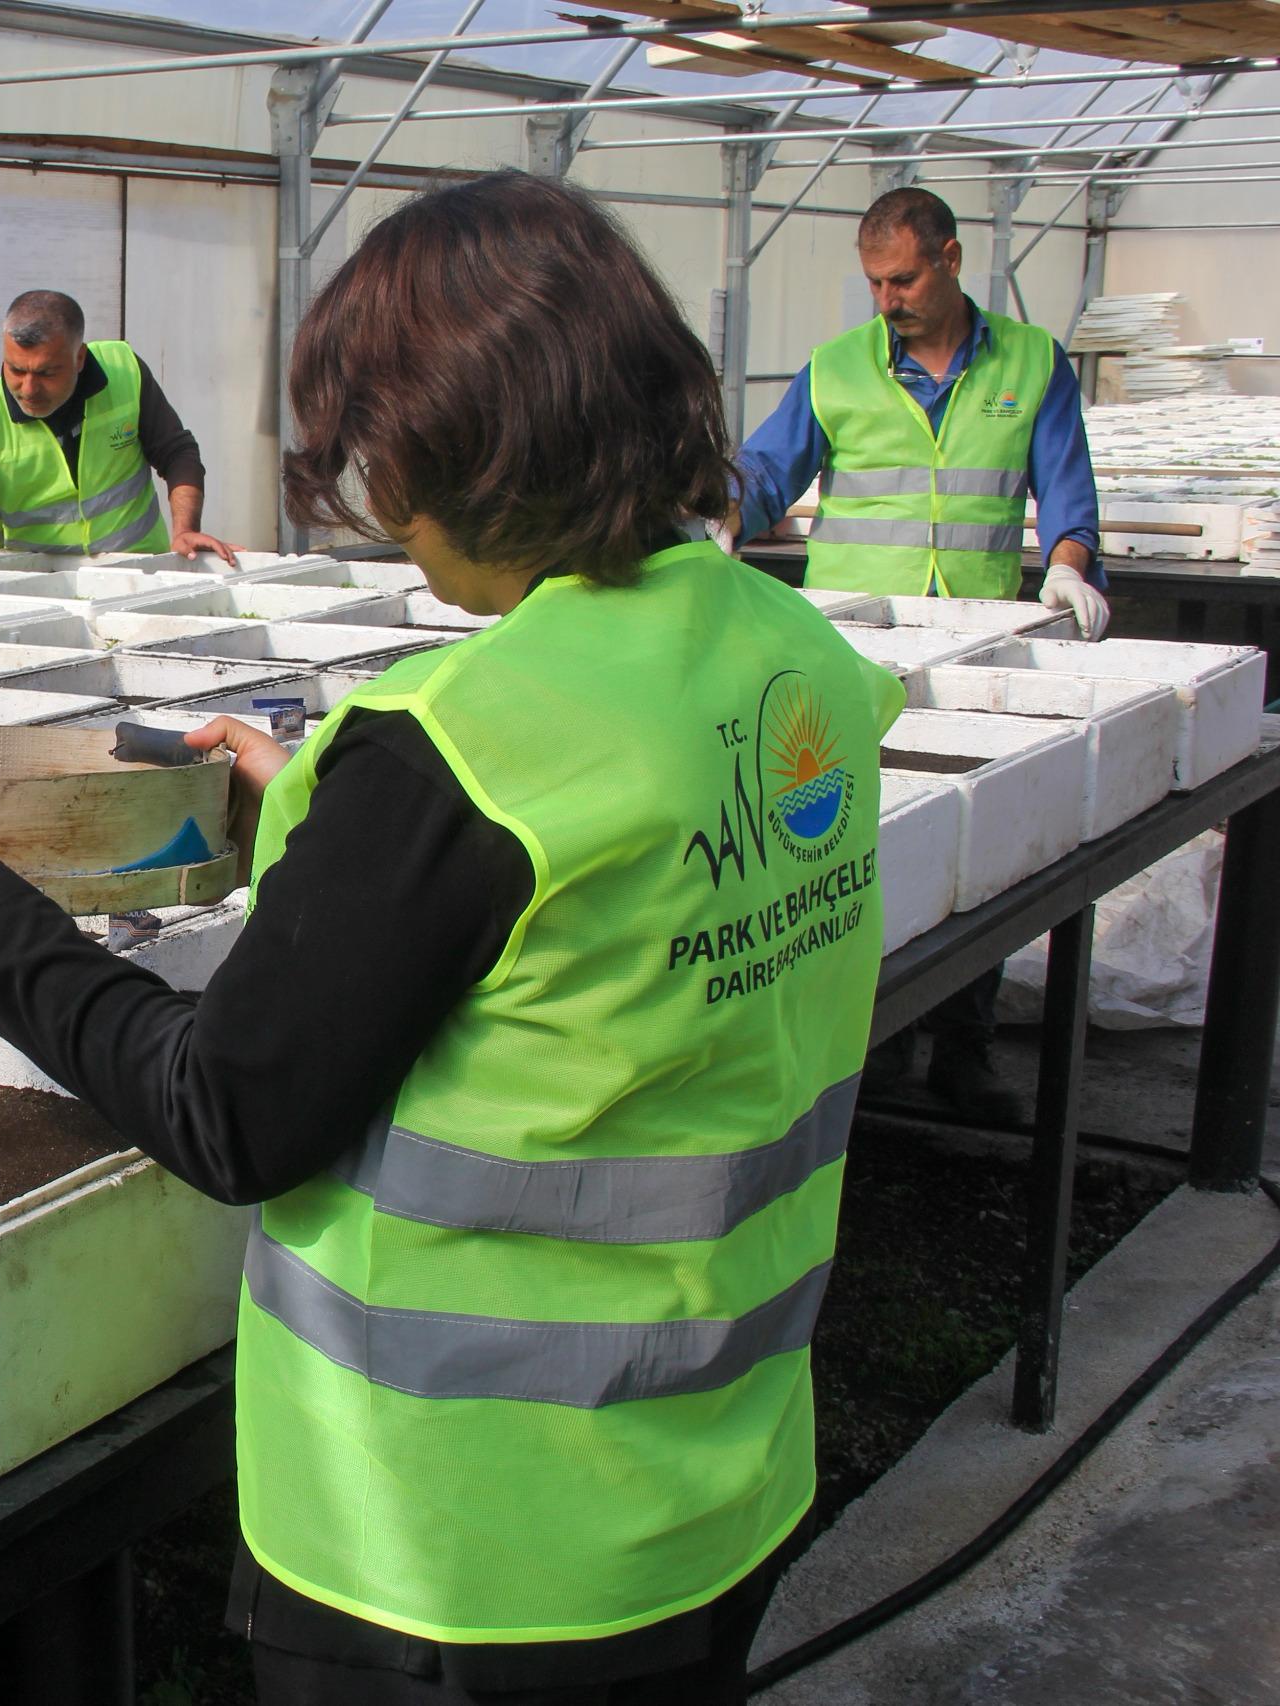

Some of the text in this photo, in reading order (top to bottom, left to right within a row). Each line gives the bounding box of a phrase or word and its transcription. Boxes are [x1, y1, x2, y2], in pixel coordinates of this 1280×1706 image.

[716, 718, 748, 748] T.C.
[768, 773, 855, 863] BÜYÜKŞEHİR BELEDİYESİ
[668, 914, 757, 971] PARK
[758, 899, 785, 942] VE
[706, 900, 863, 1005] DAİRE BAŞKANLIĞI
